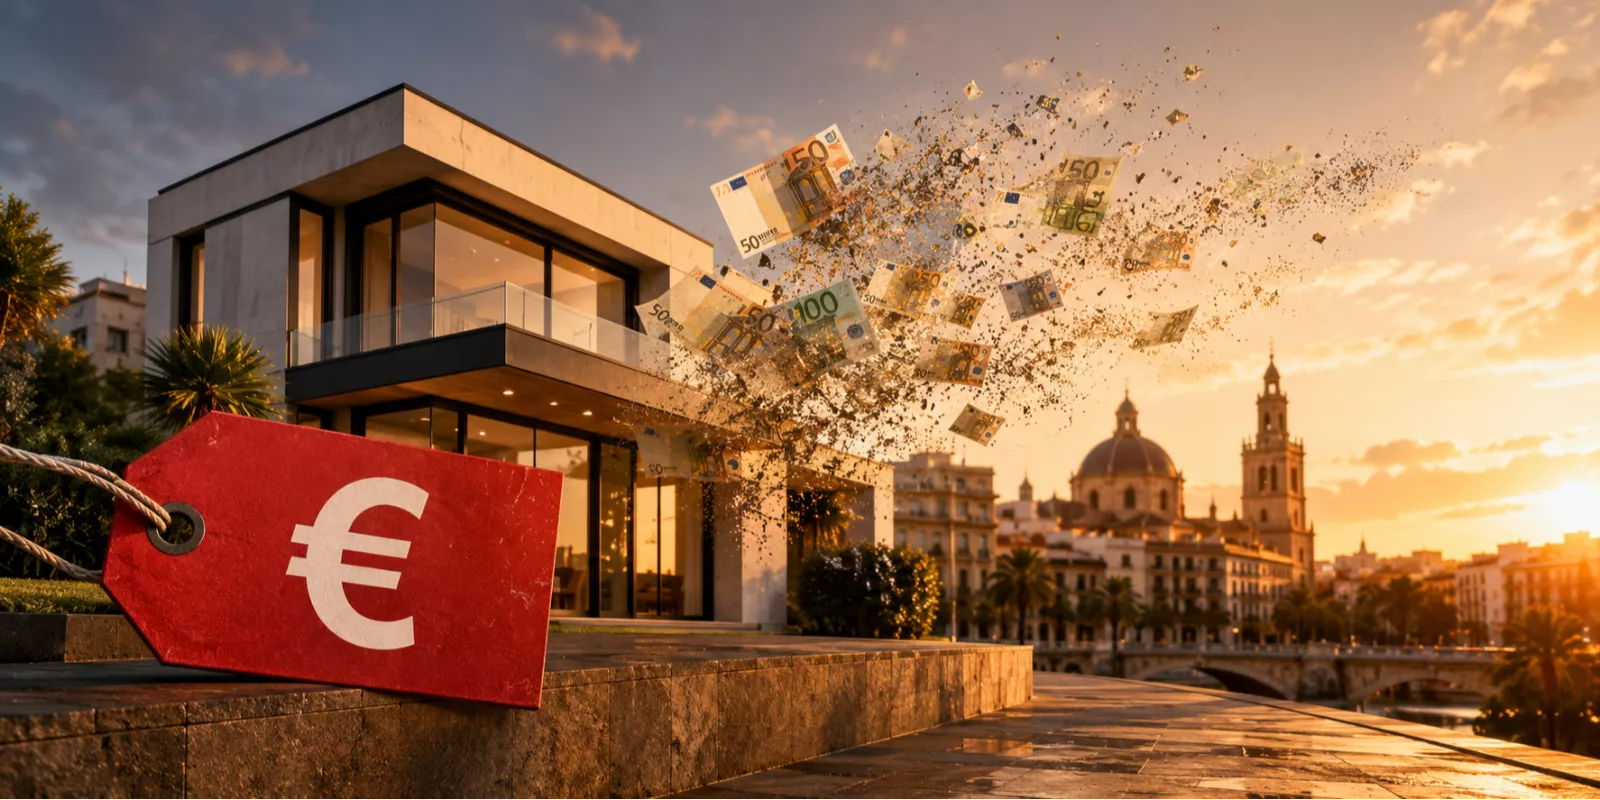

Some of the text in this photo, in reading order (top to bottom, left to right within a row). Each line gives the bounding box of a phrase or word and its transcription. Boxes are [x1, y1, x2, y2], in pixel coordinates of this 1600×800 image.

[1069, 159, 1100, 180] 50
[740, 235, 760, 253] 50
[863, 293, 876, 304] 50
[648, 303, 670, 321] 50
[286, 476, 430, 650] €
